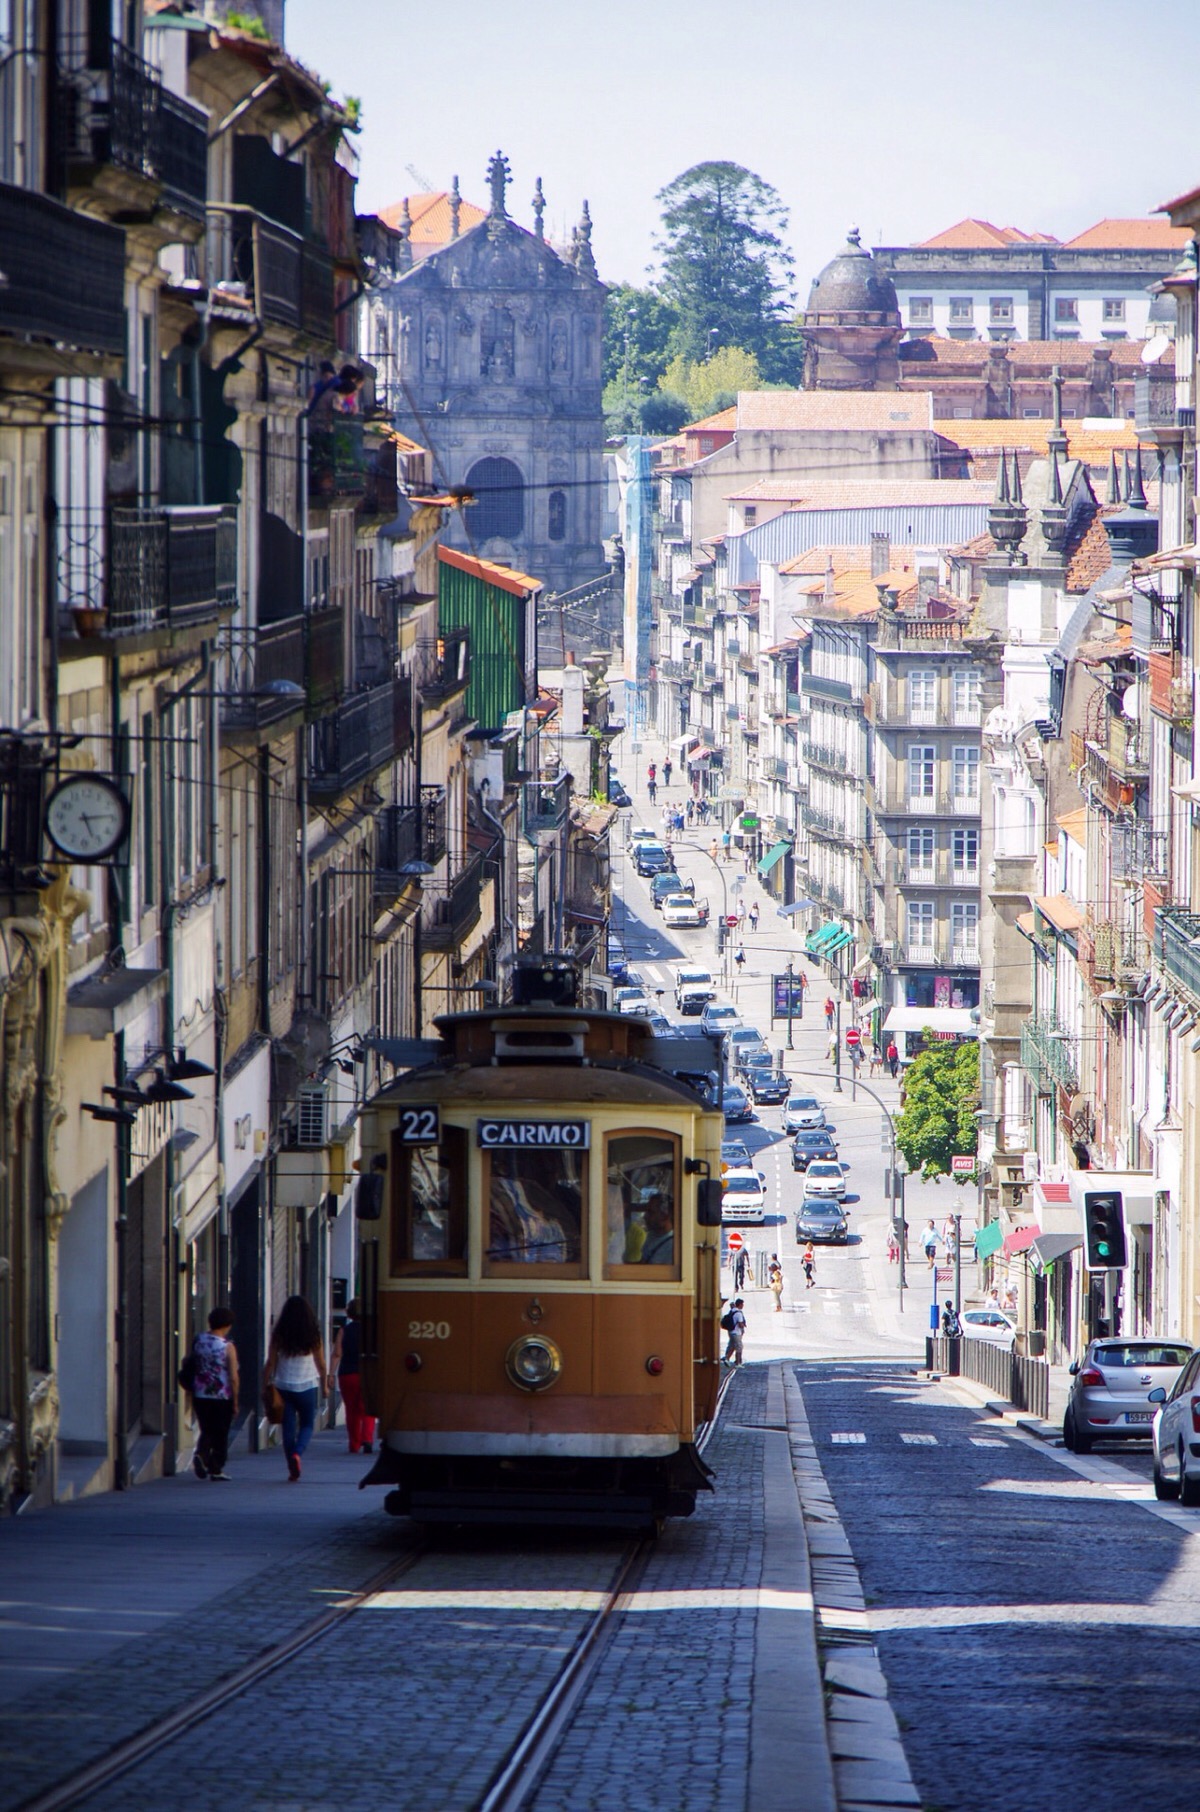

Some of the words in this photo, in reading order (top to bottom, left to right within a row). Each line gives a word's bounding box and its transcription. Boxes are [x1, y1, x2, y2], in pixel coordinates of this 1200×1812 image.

[402, 1110, 437, 1140] 22
[481, 1124, 581, 1144] CARMO
[955, 1160, 972, 1168] AVIS
[408, 1321, 451, 1340] 220
